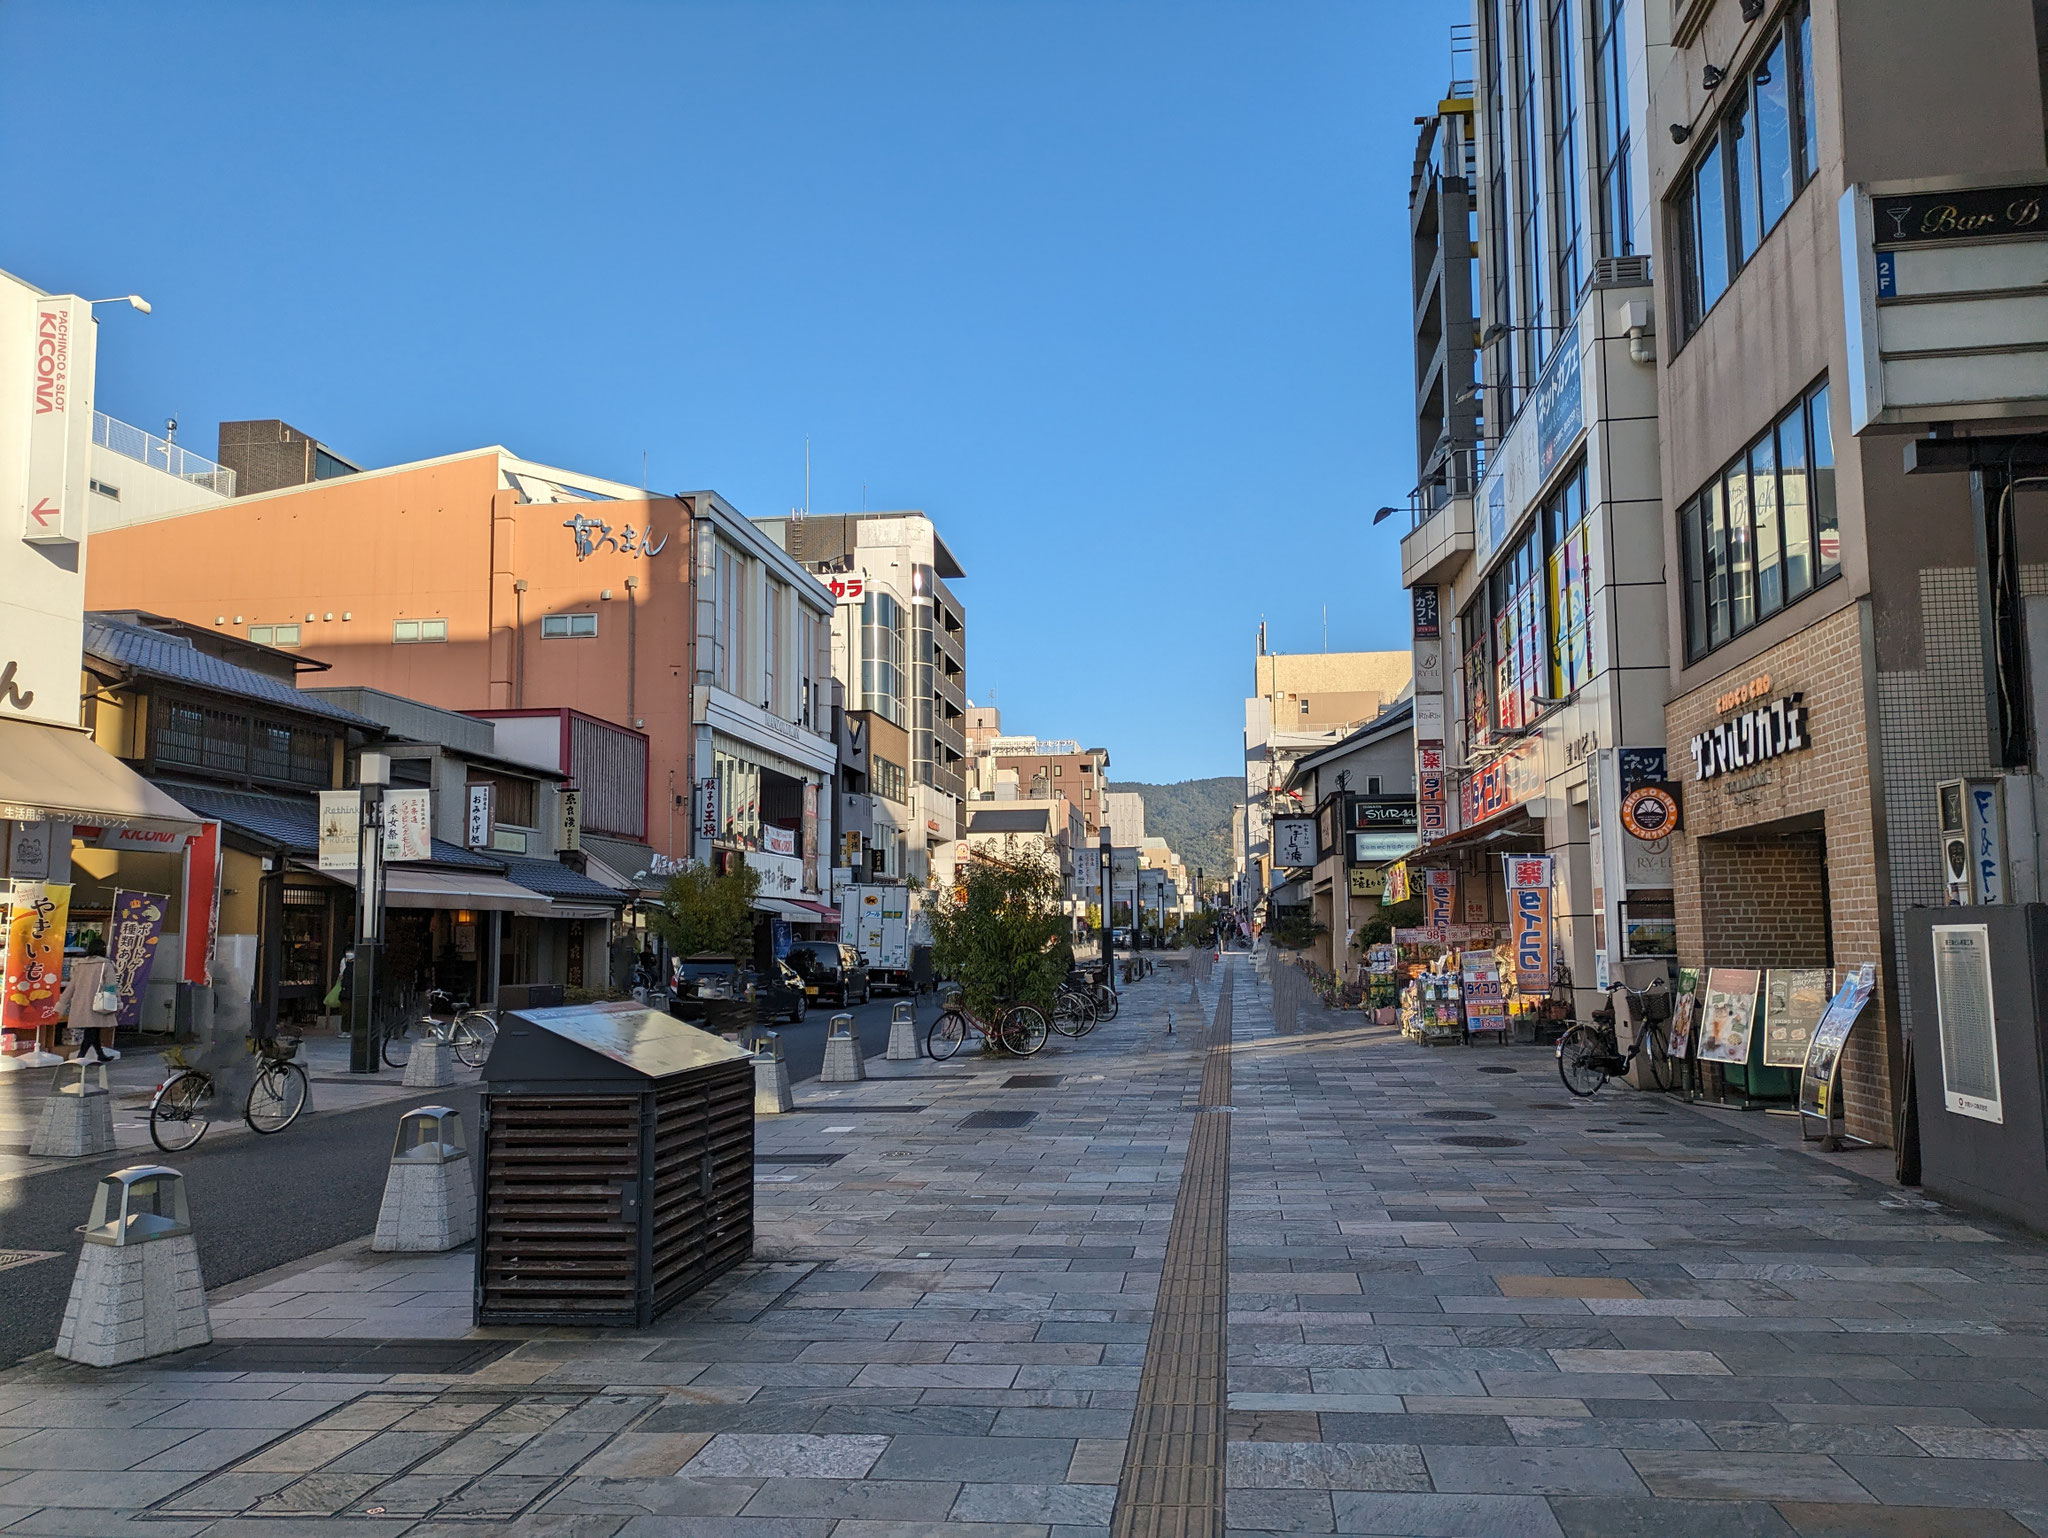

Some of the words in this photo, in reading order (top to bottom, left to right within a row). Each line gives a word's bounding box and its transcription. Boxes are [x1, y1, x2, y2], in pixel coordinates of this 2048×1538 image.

[1921, 205, 1996, 233] Bar
[1880, 262, 1890, 289] 2F
[57, 310, 68, 371] PACHINCO
[55, 384, 65, 412] SLOT
[1416, 597, 1427, 626] カフェ
[1425, 590, 1436, 619] ネット
[1716, 685, 1748, 714] CHOCO
[1749, 674, 1772, 699] CRO
[1691, 692, 1804, 781] サンマルクカフェ
[1423, 750, 1441, 769] 薬
[703, 779, 717, 837] 餃子の王将
[1424, 777, 1441, 827] ダイコク
[1623, 788, 1657, 813] CHOCO
[471, 795, 482, 844] おみやげ処
[24, 897, 56, 982] やきいも
[1426, 930, 1440, 940] 98
[1480, 927, 1494, 938] 68
[122, 923, 150, 996] ボードゲーム
